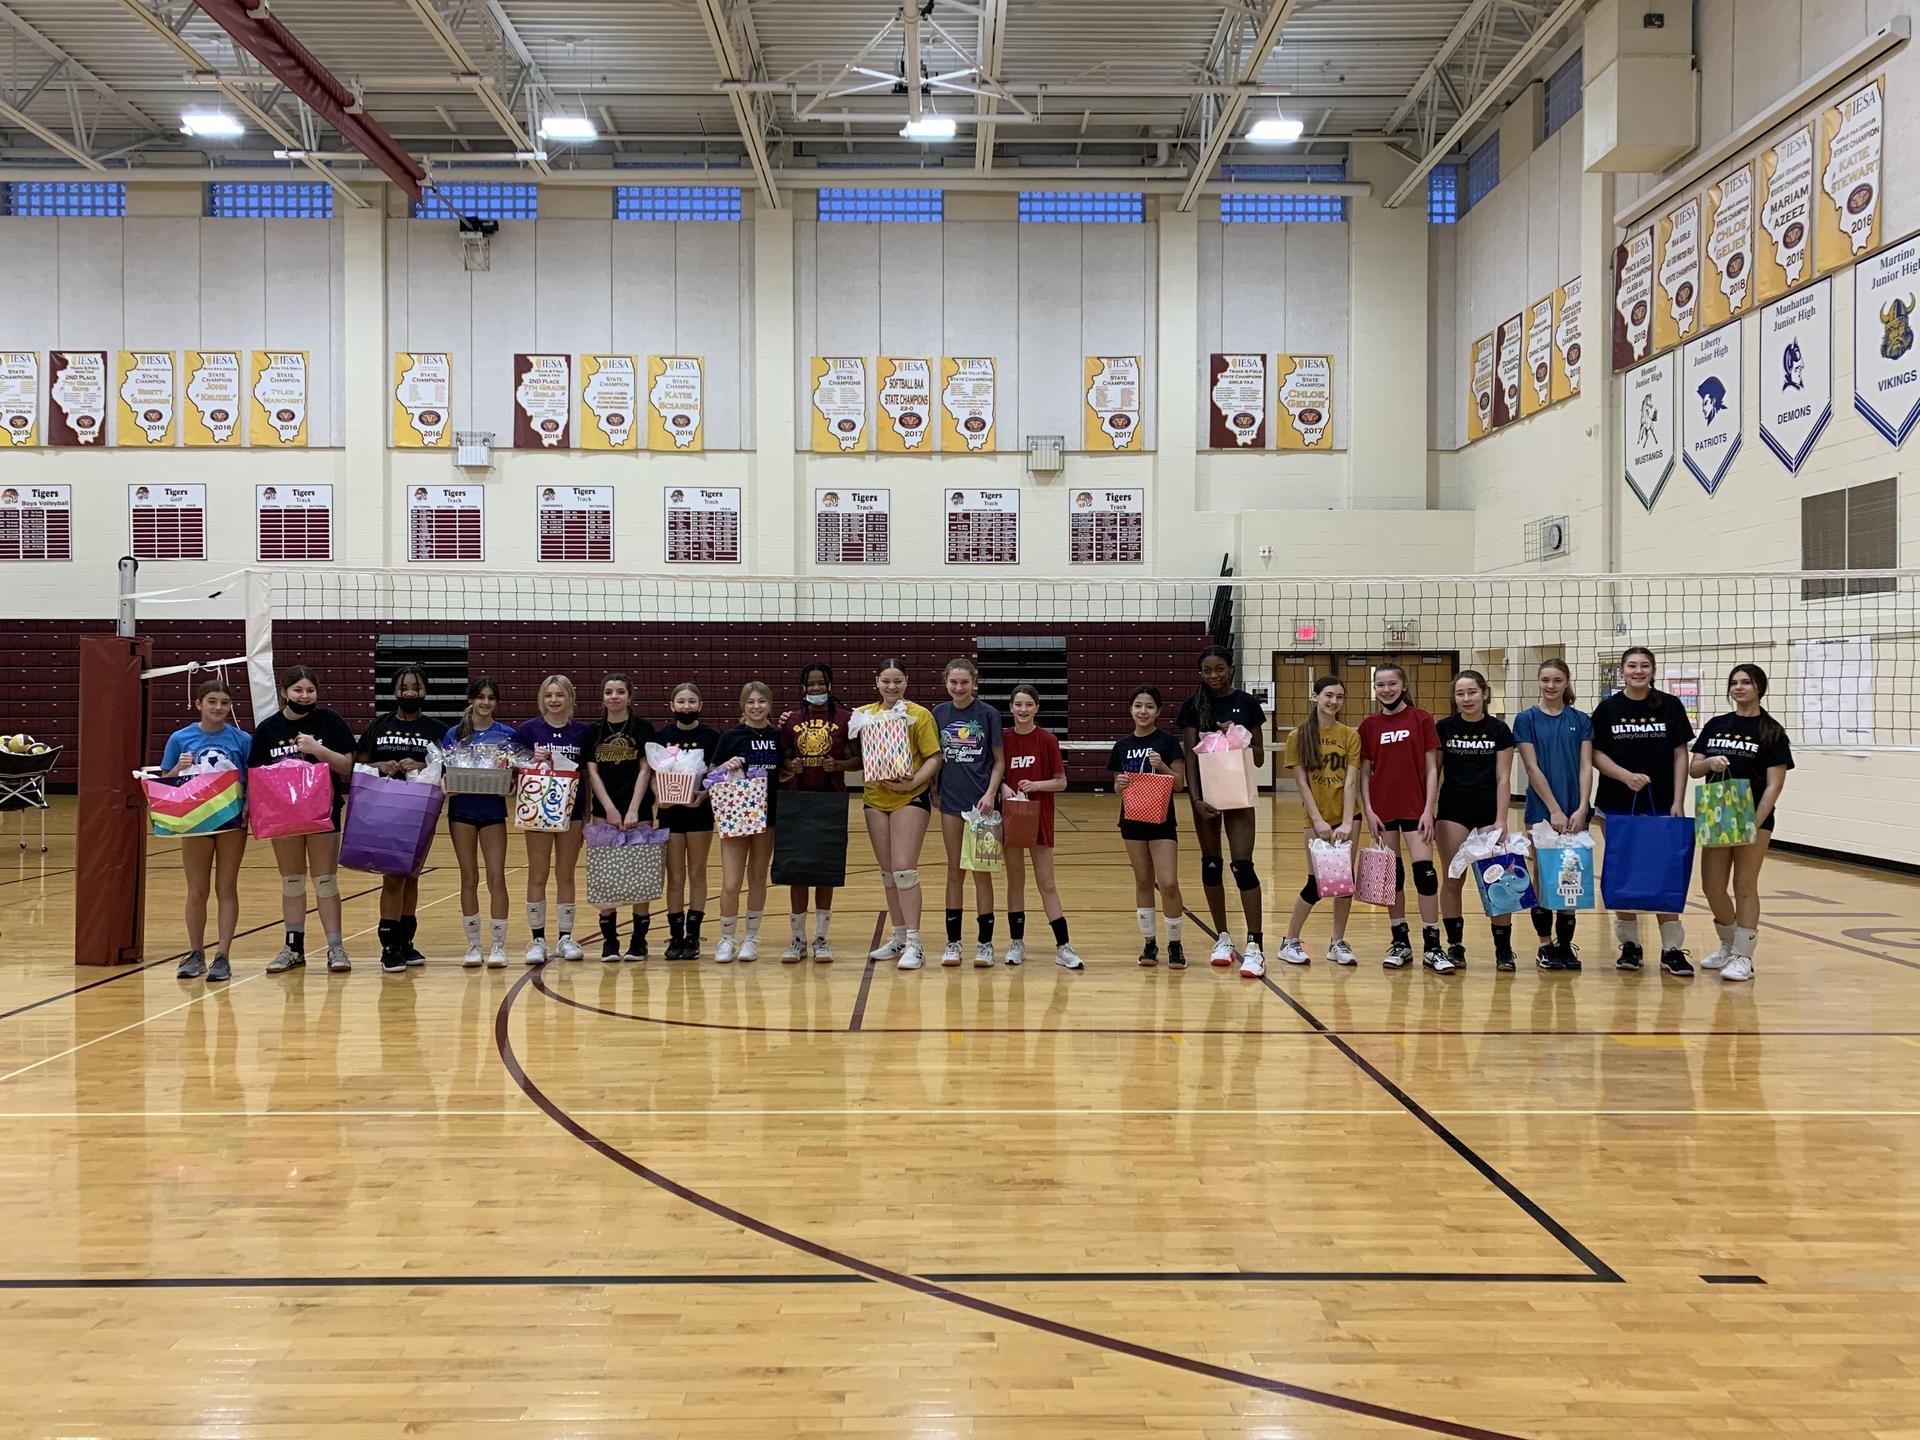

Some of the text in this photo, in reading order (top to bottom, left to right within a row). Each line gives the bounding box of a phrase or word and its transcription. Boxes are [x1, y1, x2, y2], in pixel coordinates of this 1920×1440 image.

[1853, 90, 1876, 116] IESA
[1786, 134, 1808, 158] IESA
[1833, 125, 1880, 158] STATE CHAMPION
[1839, 145, 1871, 174] KATIE
[1830, 158, 1881, 194] STEWART
[1729, 171, 1749, 194] IESA
[1770, 183, 1784, 198] STATE
[1784, 169, 1811, 189] CHAMPION
[1770, 183, 1809, 216] MARIAM
[1680, 206, 1696, 226] IESA
[1773, 203, 1806, 231] AZEEZ
[1851, 213, 1873, 234] 2018
[1715, 217, 1747, 244] CHLOE
[1634, 237, 1649, 254] IESA
[1786, 248, 1805, 267] 2018
[1880, 247, 1915, 271] Martino
[1872, 269, 1900, 290] Junior
[1729, 280, 1746, 296] 2018
[1776, 293, 1814, 317] Manhattan
[1678, 307, 1693, 321] 2018
[1773, 306, 1816, 332] Junior High
[1633, 329, 1646, 344] 2018
[1701, 336, 1721, 352] Liberty
[11, 353, 31, 363] IESA
[78, 355, 99, 365] IESA
[146, 355, 167, 365] IESA
[212, 355, 233, 365] IESA
[280, 355, 301, 365] IESA
[423, 355, 444, 365] IESA
[1693, 344, 1729, 367] Junior High
[542, 359, 563, 369] IESA
[608, 359, 629, 369] IESA
[675, 360, 696, 370] IESA
[838, 359, 859, 369] IESA
[904, 361, 924, 371] IESA
[968, 360, 988, 370] IESA
[1113, 359, 1134, 368] IESA
[1238, 358, 1258, 368] IESA
[1304, 359, 1325, 369] IESA
[889, 378, 914, 389] SOFTBALL
[1635, 371, 1663, 390] Junior High
[1877, 369, 1918, 392] VIKINGS
[664, 391, 693, 399] KATIE
[885, 394, 928, 405] STATE CHAMPIONS
[1288, 389, 1326, 399] CHLOE
[1777, 404, 1812, 425] DEMONS
[904, 430, 924, 438] 2017
[1695, 432, 1728, 452] PATRIOTS
[1634, 449, 1664, 466] MUSTANGS
[32, 489, 59, 499] Tigers
[164, 488, 188, 497] Tigers
[292, 489, 315, 497] Tigers
[443, 489, 466, 498] Tigers
[572, 487, 596, 496] Tigers
[700, 490, 723, 498] Tigers
[980, 491, 1003, 500] Tigers
[852, 493, 878, 503] Tigers
[1105, 492, 1132, 503] Tigers
[1392, 630, 1406, 640] EXIT
[1611, 723, 1667, 734] ULTIMATE
[376, 736, 429, 746] ULTIMATE
[1380, 729, 1411, 745] EVP
[1613, 732, 1649, 740] volleyball
[751, 740, 777, 750] LWE
[1446, 739, 1496, 749] ULTIMATE
[1010, 755, 1036, 769] EVP
